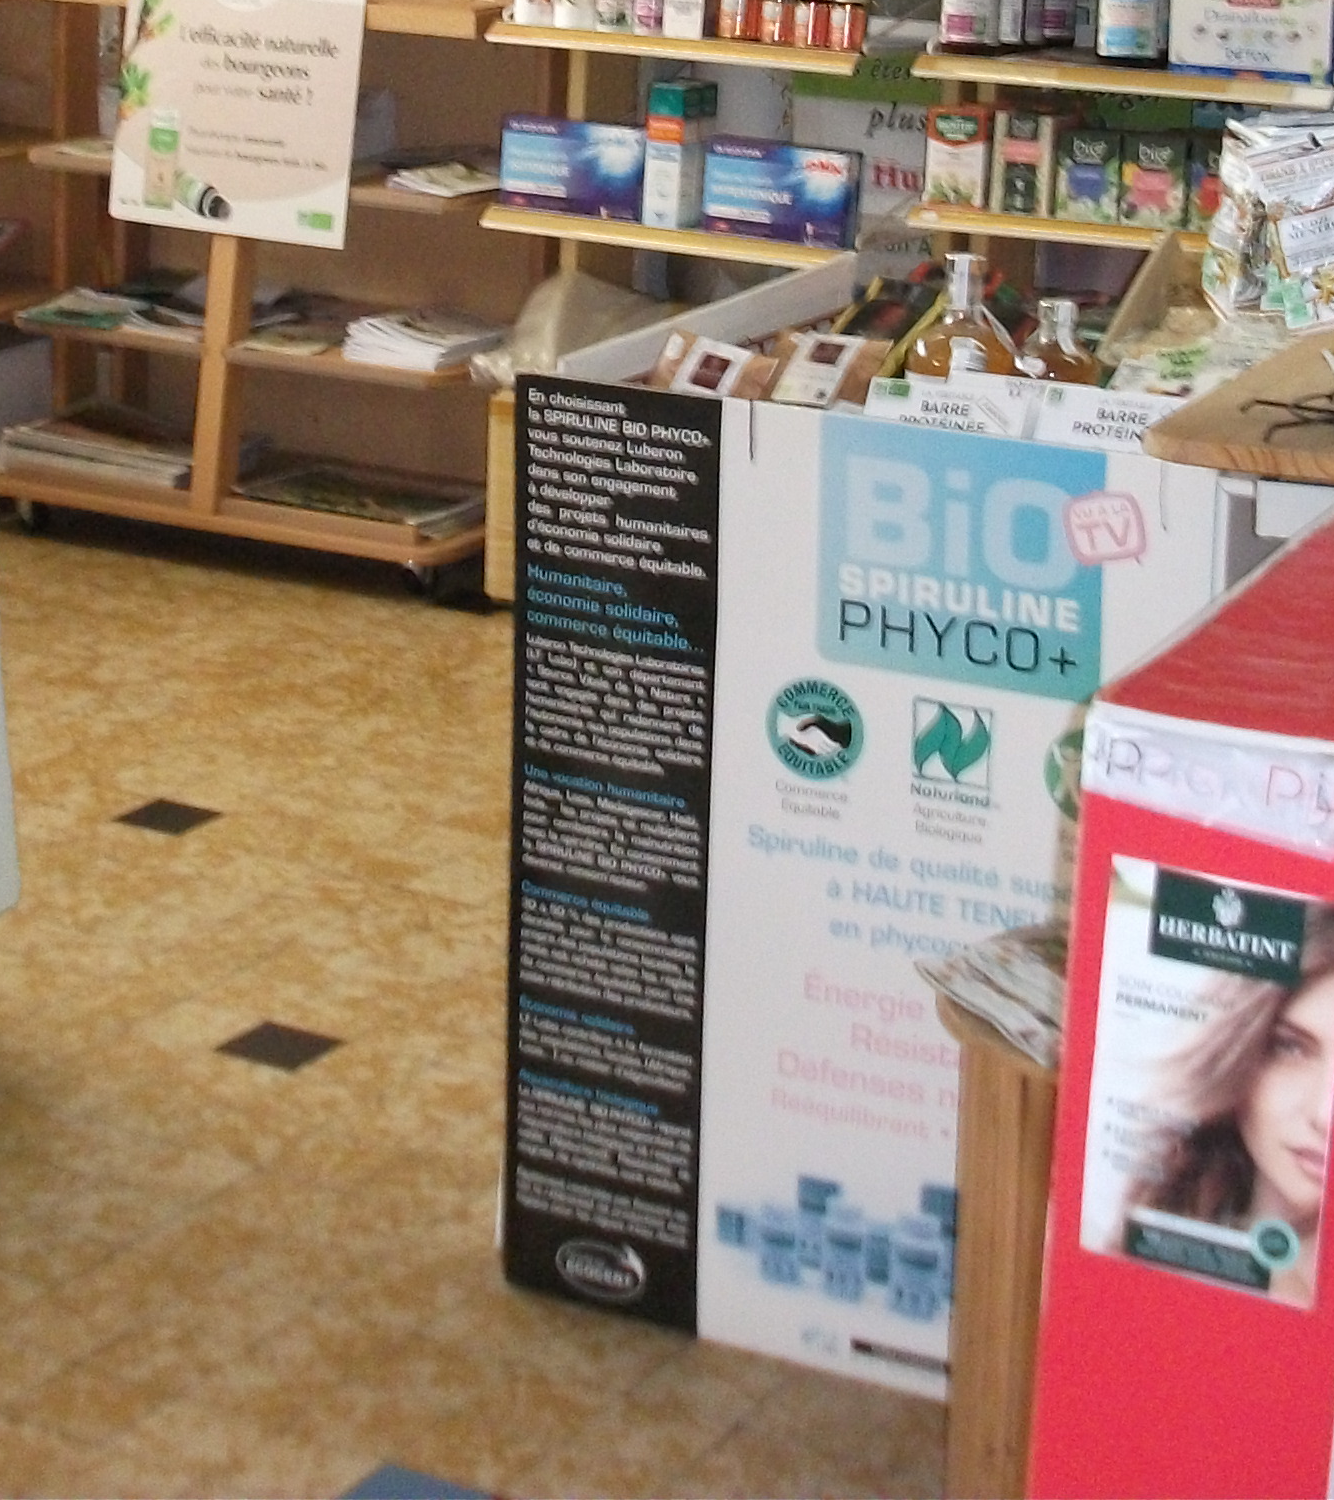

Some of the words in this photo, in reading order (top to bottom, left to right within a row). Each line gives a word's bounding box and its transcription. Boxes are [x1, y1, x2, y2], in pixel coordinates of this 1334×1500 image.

[528, 387, 545, 403] En
[549, 391, 627, 416] choisissant
[920, 399, 970, 416] BARRE
[1096, 407, 1149, 425] BARRE
[528, 406, 541, 423] la
[543, 409, 619, 433] SPIRULINE
[622, 420, 649, 438] BIO
[527, 427, 559, 444] vous
[561, 432, 624, 455] soutenez
[626, 440, 685, 463] Luberon
[527, 443, 613, 473] Technologies
[615, 457, 699, 484] Laboratoire
[527, 462, 560, 481] dans
[563, 470, 588, 486] son
[590, 476, 678, 500] engagement
[539, 483, 614, 508] développer
[527, 499, 552, 517] des
[559, 507, 608, 527] projets
[615, 513, 710, 542] humanitaires
[527, 518, 601, 544] d'économie
[603, 531, 664, 553] solidaire
[846, 453, 1081, 593] BiO
[1073, 516, 1131, 551] TV
[527, 538, 542, 552] et
[544, 540, 561, 555] de
[564, 545, 636, 569] commerce
[527, 563, 629, 597] Humanitaire,
[838, 561, 1081, 634] SPIRULINE
[527, 586, 600, 613] économie
[605, 602, 680, 629] solidaire,
[527, 610, 608, 638] commerce
[838, 598, 1078, 675] PHYCO+
[776, 679, 856, 719] COMMERCE
[776, 742, 850, 776] EQUITABLE
[747, 824, 859, 868] Spiruline
[868, 844, 900, 875] de
[909, 851, 1001, 890] qualité
[851, 878, 945, 919] HAUTE
[828, 914, 859, 938] en
[1158, 912, 1298, 964] HERBATINT
[802, 969, 925, 1023] Énergie
